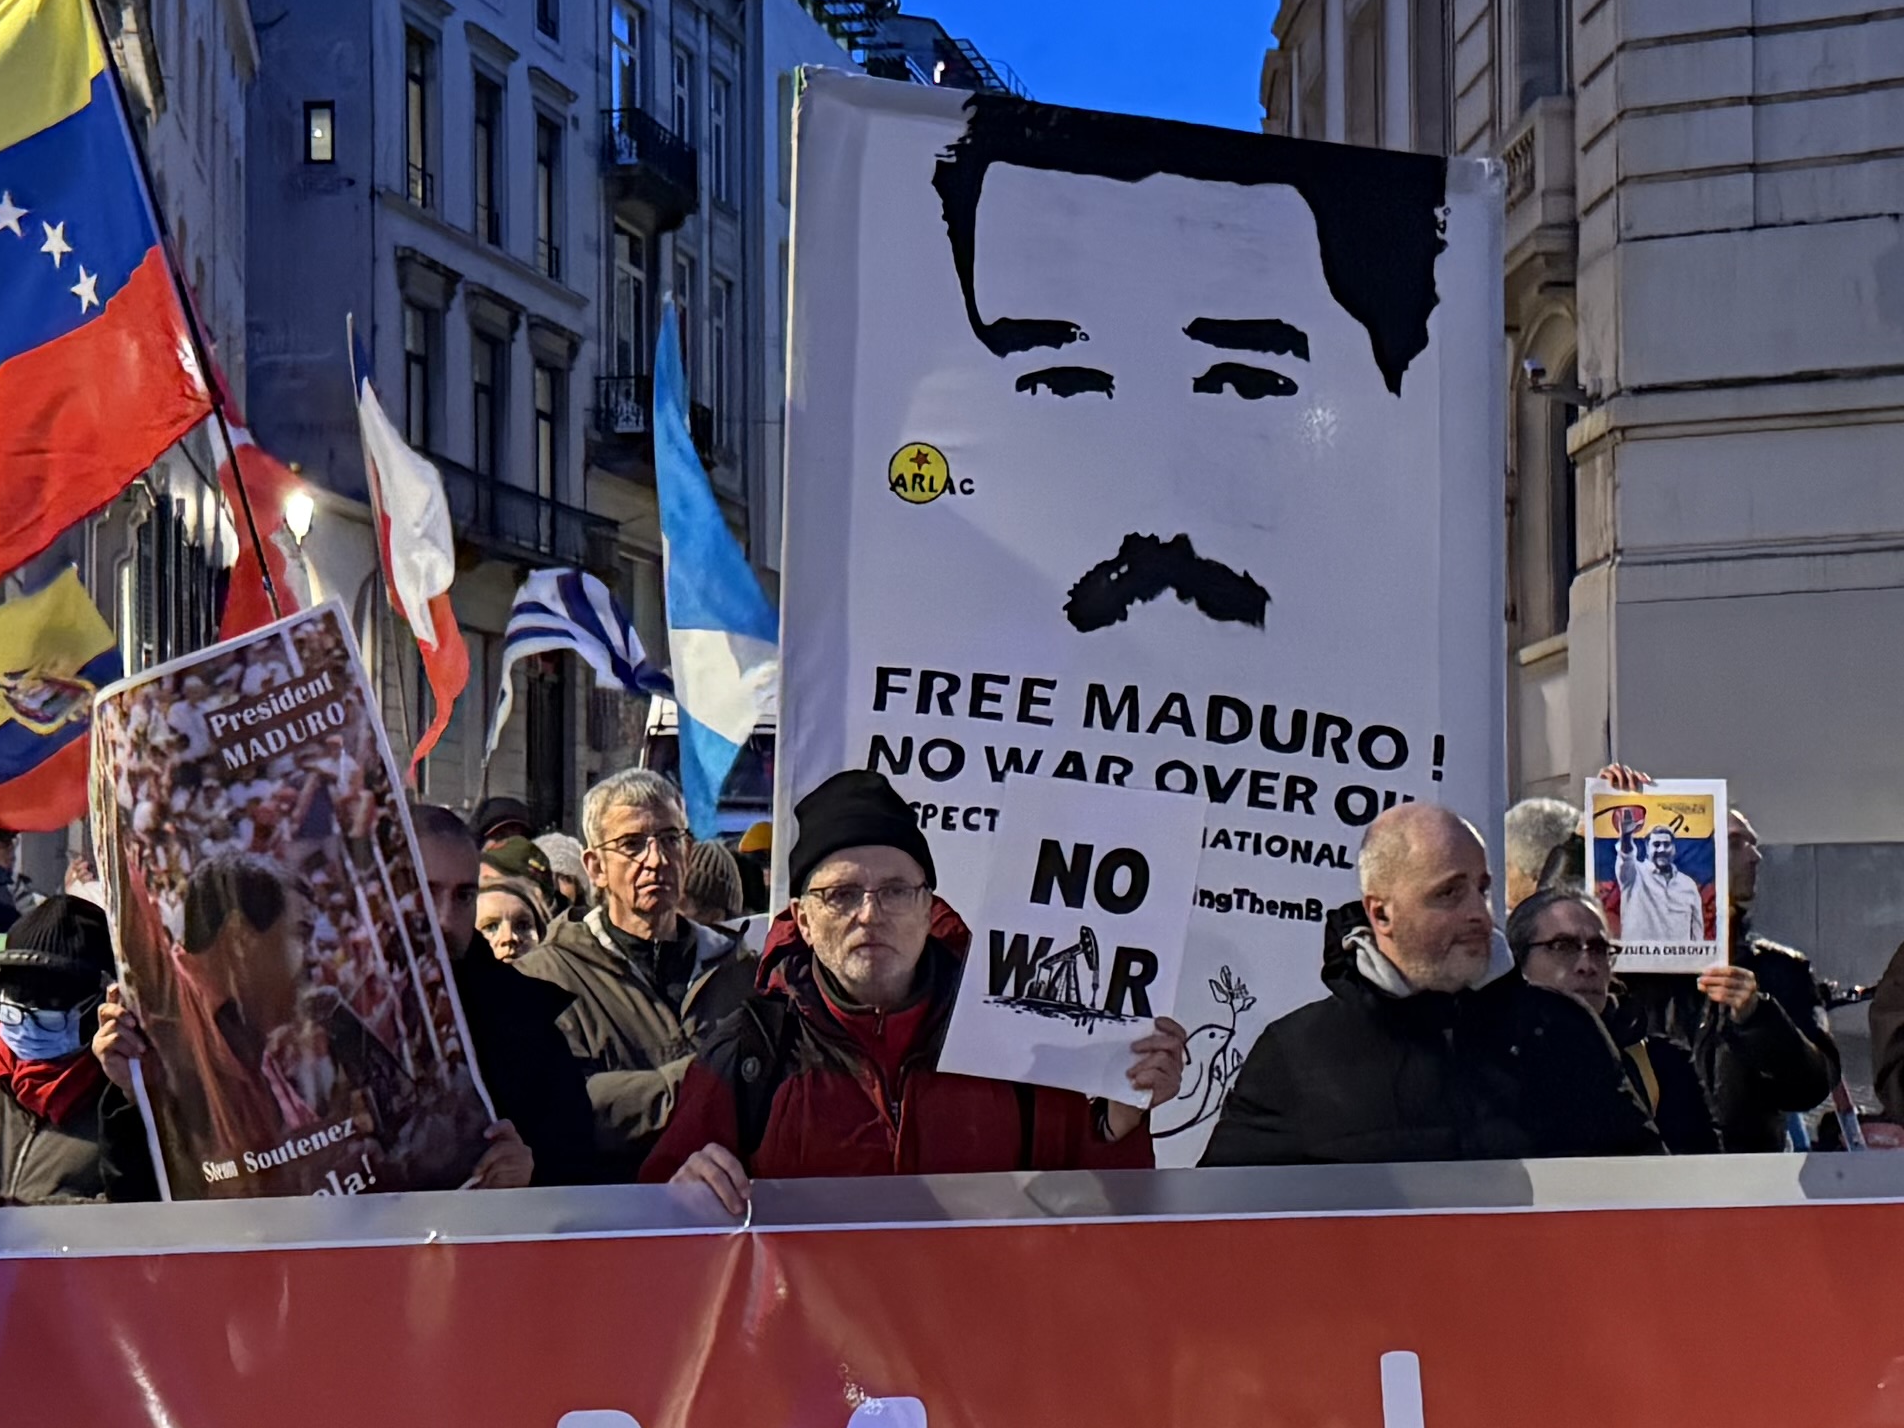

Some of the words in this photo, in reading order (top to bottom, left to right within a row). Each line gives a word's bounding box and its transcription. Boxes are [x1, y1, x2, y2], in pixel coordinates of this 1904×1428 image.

[889, 472, 975, 495] ARLAC
[209, 670, 334, 739] President
[221, 701, 346, 771] MADURO
[873, 666, 1058, 727] FREE
[1083, 682, 1409, 771] MADURO
[867, 734, 966, 783] NO
[985, 745, 1135, 787] WAR
[1154, 758, 1319, 816] OVER
[1030, 838, 1150, 915] NO
[243, 1117, 357, 1174] Soutenez
